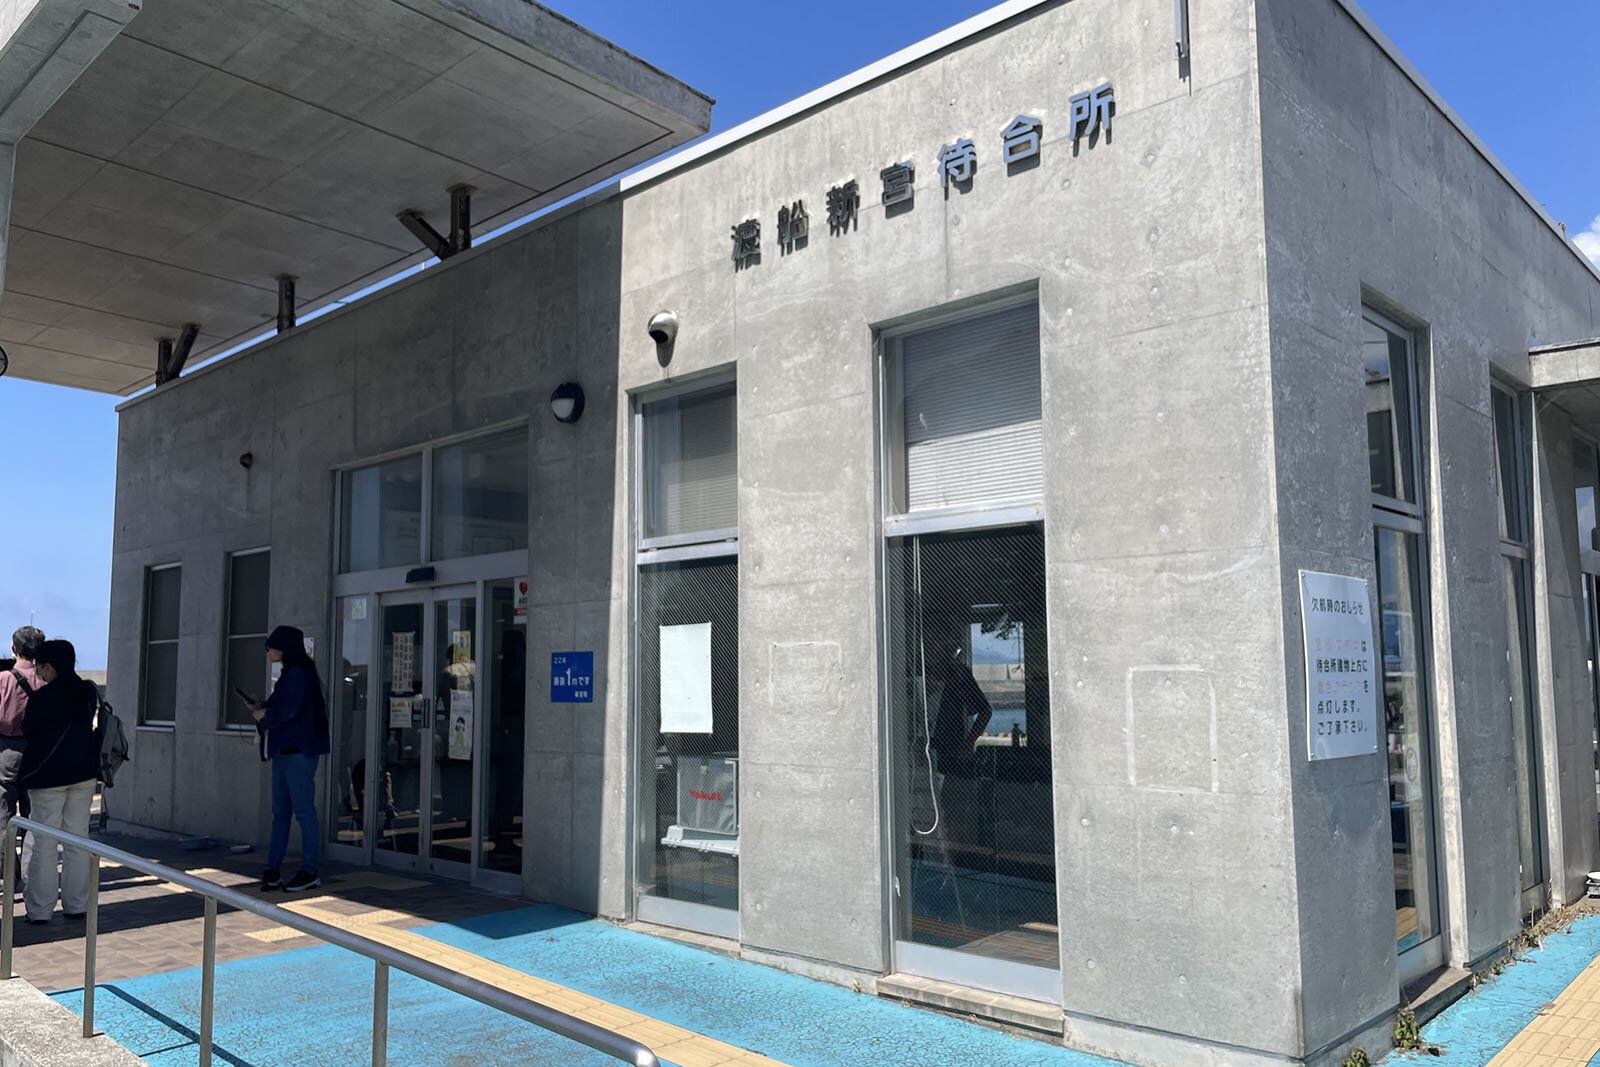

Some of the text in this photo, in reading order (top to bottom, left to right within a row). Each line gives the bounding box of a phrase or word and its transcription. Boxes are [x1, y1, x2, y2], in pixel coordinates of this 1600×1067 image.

[1311, 597, 1364, 615] 欠航時のおしらせ
[1316, 658, 1368, 673] 待合所建物上方に
